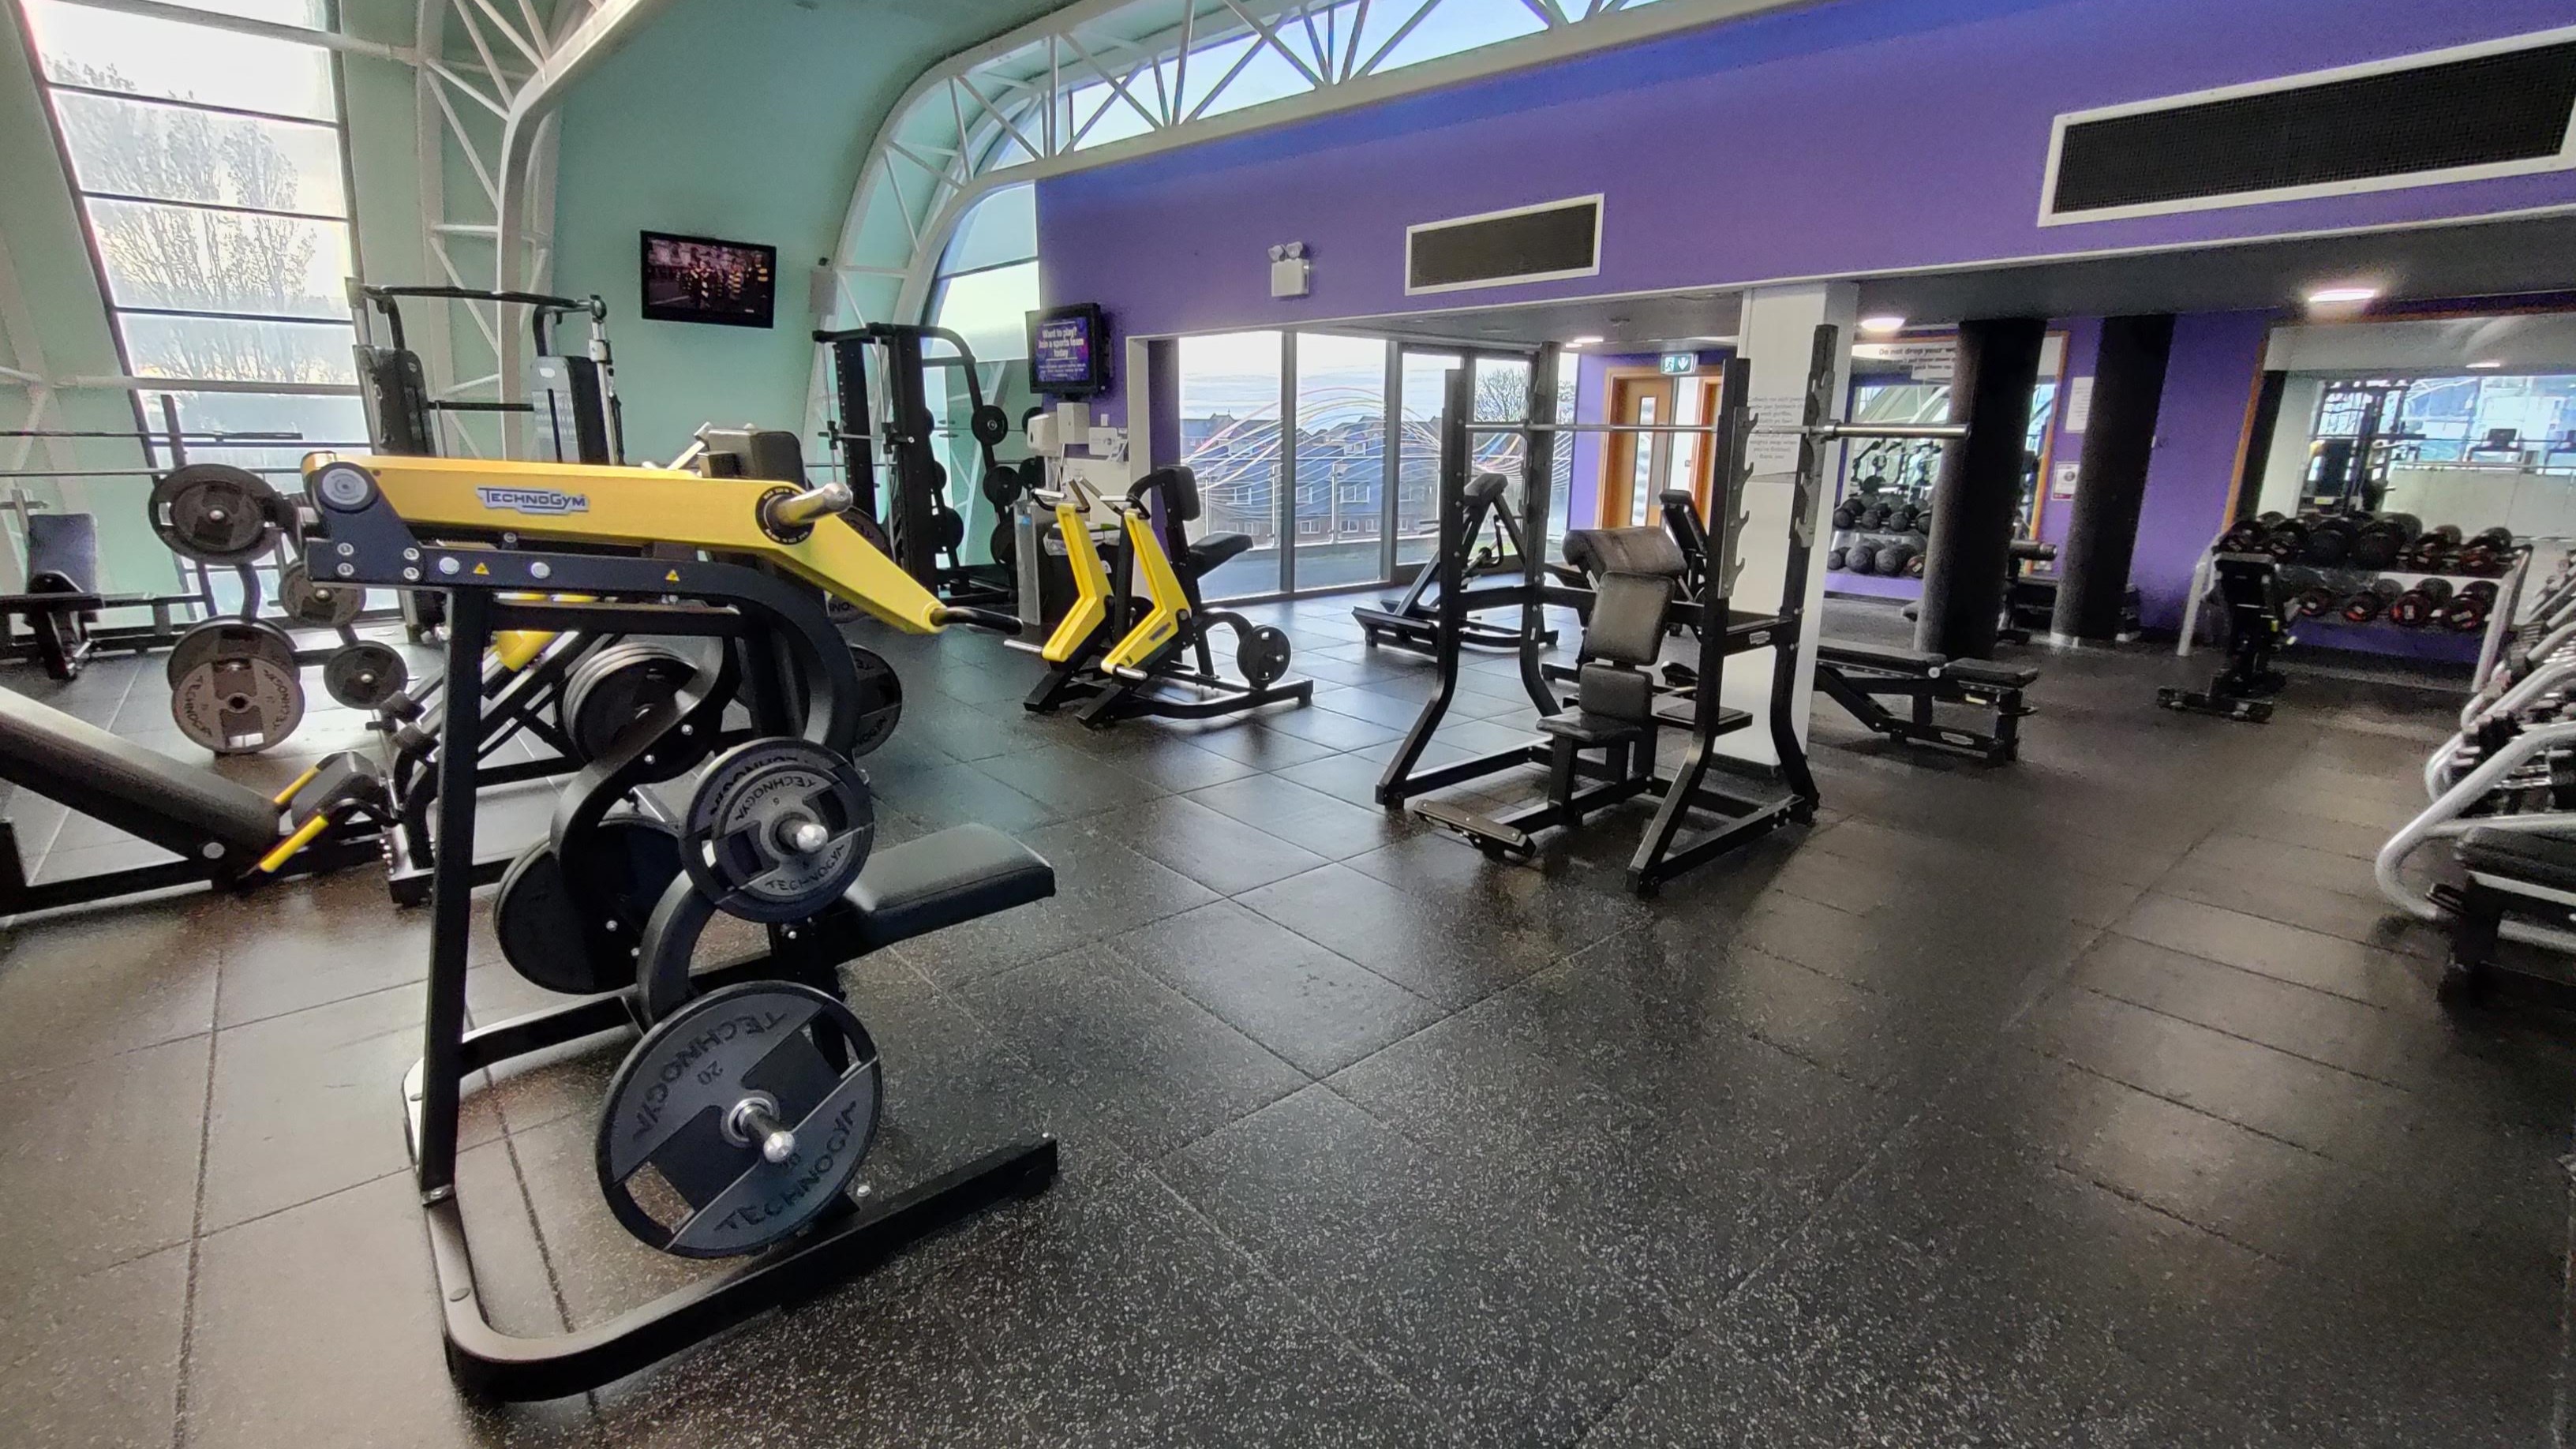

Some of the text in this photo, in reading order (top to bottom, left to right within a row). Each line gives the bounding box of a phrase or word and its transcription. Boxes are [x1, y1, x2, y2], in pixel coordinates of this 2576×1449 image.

[1043, 328, 1056, 339] Want
[1056, 328, 1062, 338] to
[1054, 350, 1069, 359] today
[1904, 347, 1923, 357] drop
[1924, 348, 1943, 358] your
[697, 1060, 724, 1085] 20
